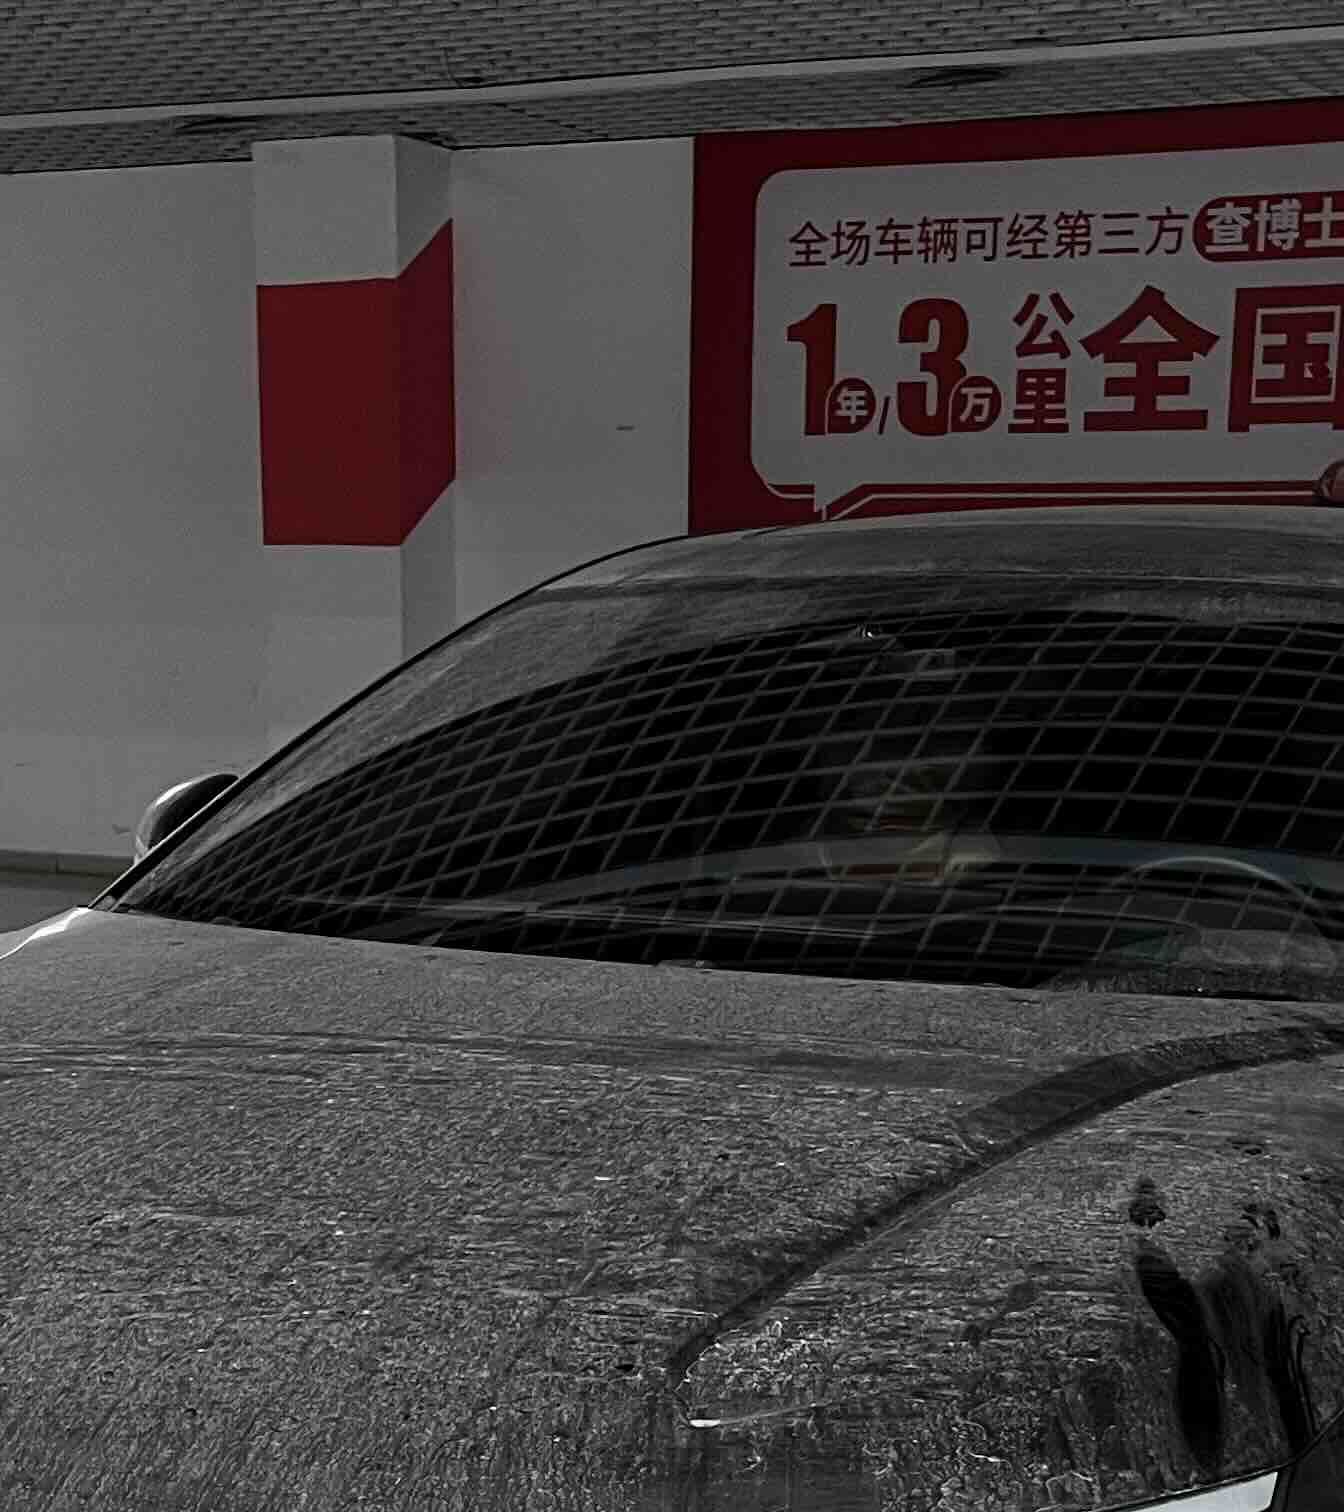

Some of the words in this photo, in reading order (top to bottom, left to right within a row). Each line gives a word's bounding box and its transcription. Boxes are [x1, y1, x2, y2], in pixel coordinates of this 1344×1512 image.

[787, 207, 1191, 267] 全场车辆可经第三方
